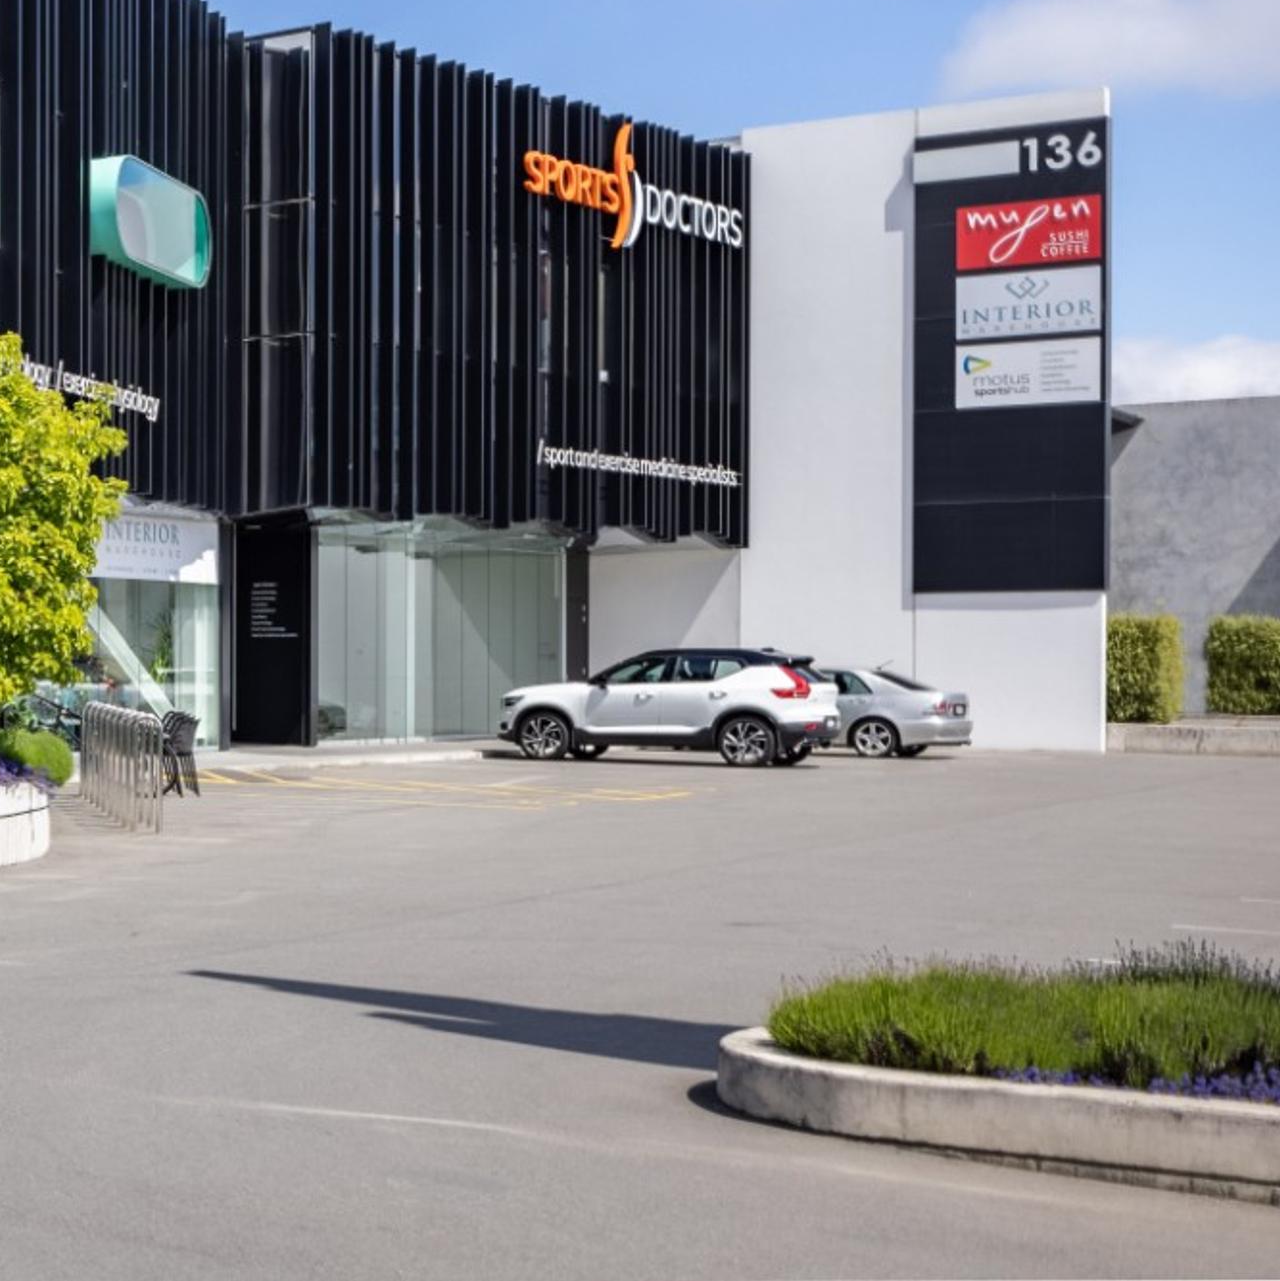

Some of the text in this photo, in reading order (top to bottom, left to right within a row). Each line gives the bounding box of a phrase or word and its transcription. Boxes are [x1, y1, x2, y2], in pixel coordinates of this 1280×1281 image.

[1022, 130, 1103, 173] 136
[523, 150, 743, 248] SPORTS DOCTORS
[1049, 229, 1089, 243] SUSHI
[961, 299, 1094, 325] INTERIOR
[972, 373, 1030, 387] motus
[974, 385, 1030, 399] sportshub
[105, 521, 181, 545] INTERIOR
